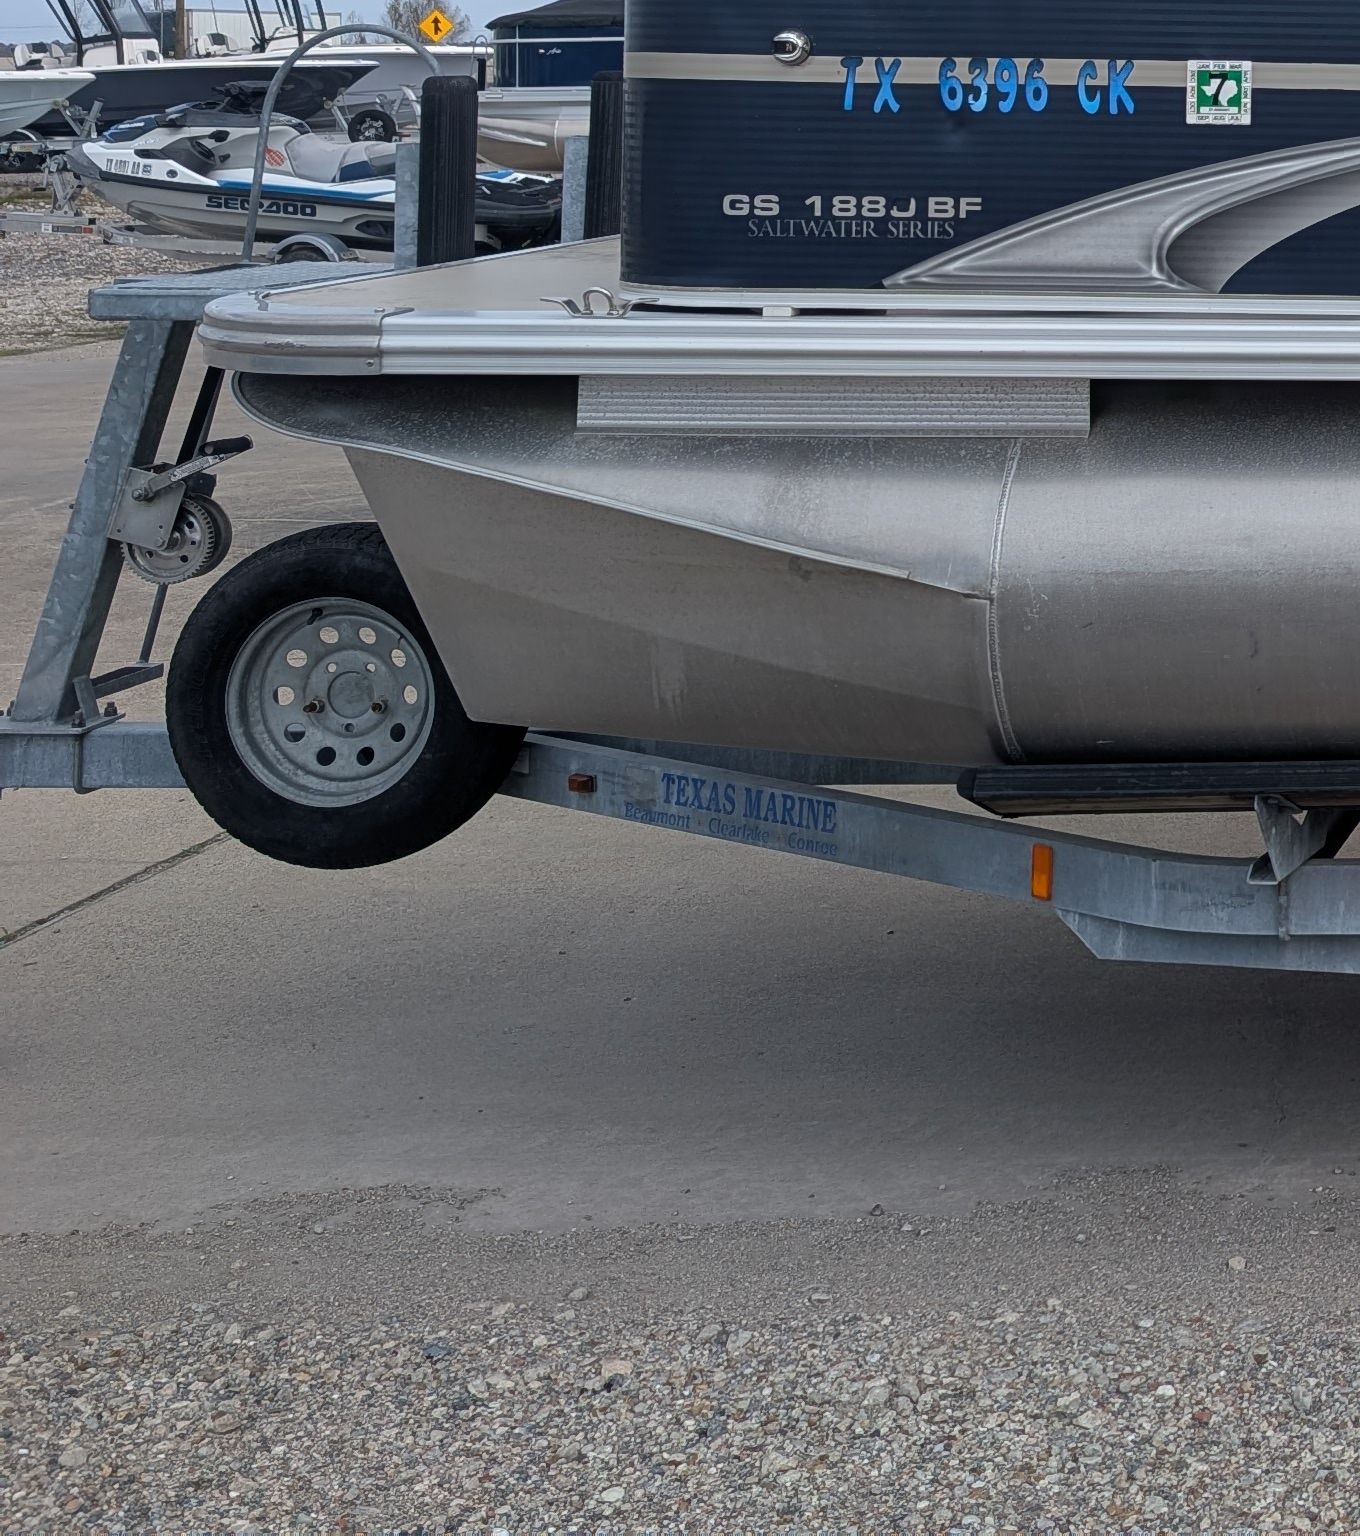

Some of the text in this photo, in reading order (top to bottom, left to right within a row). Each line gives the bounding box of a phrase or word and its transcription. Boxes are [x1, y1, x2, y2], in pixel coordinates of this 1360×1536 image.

[840, 56, 1135, 115] TX 6396 CK
[1208, 72, 1229, 106] 7
[723, 194, 780, 216] GS
[927, 196, 982, 219] BF
[747, 218, 955, 240] SALTWATER SERIES
[661, 772, 837, 834] TEXAS MARINE
[624, 801, 691, 830] Beaumont
[787, 831, 838, 857] Conroe
